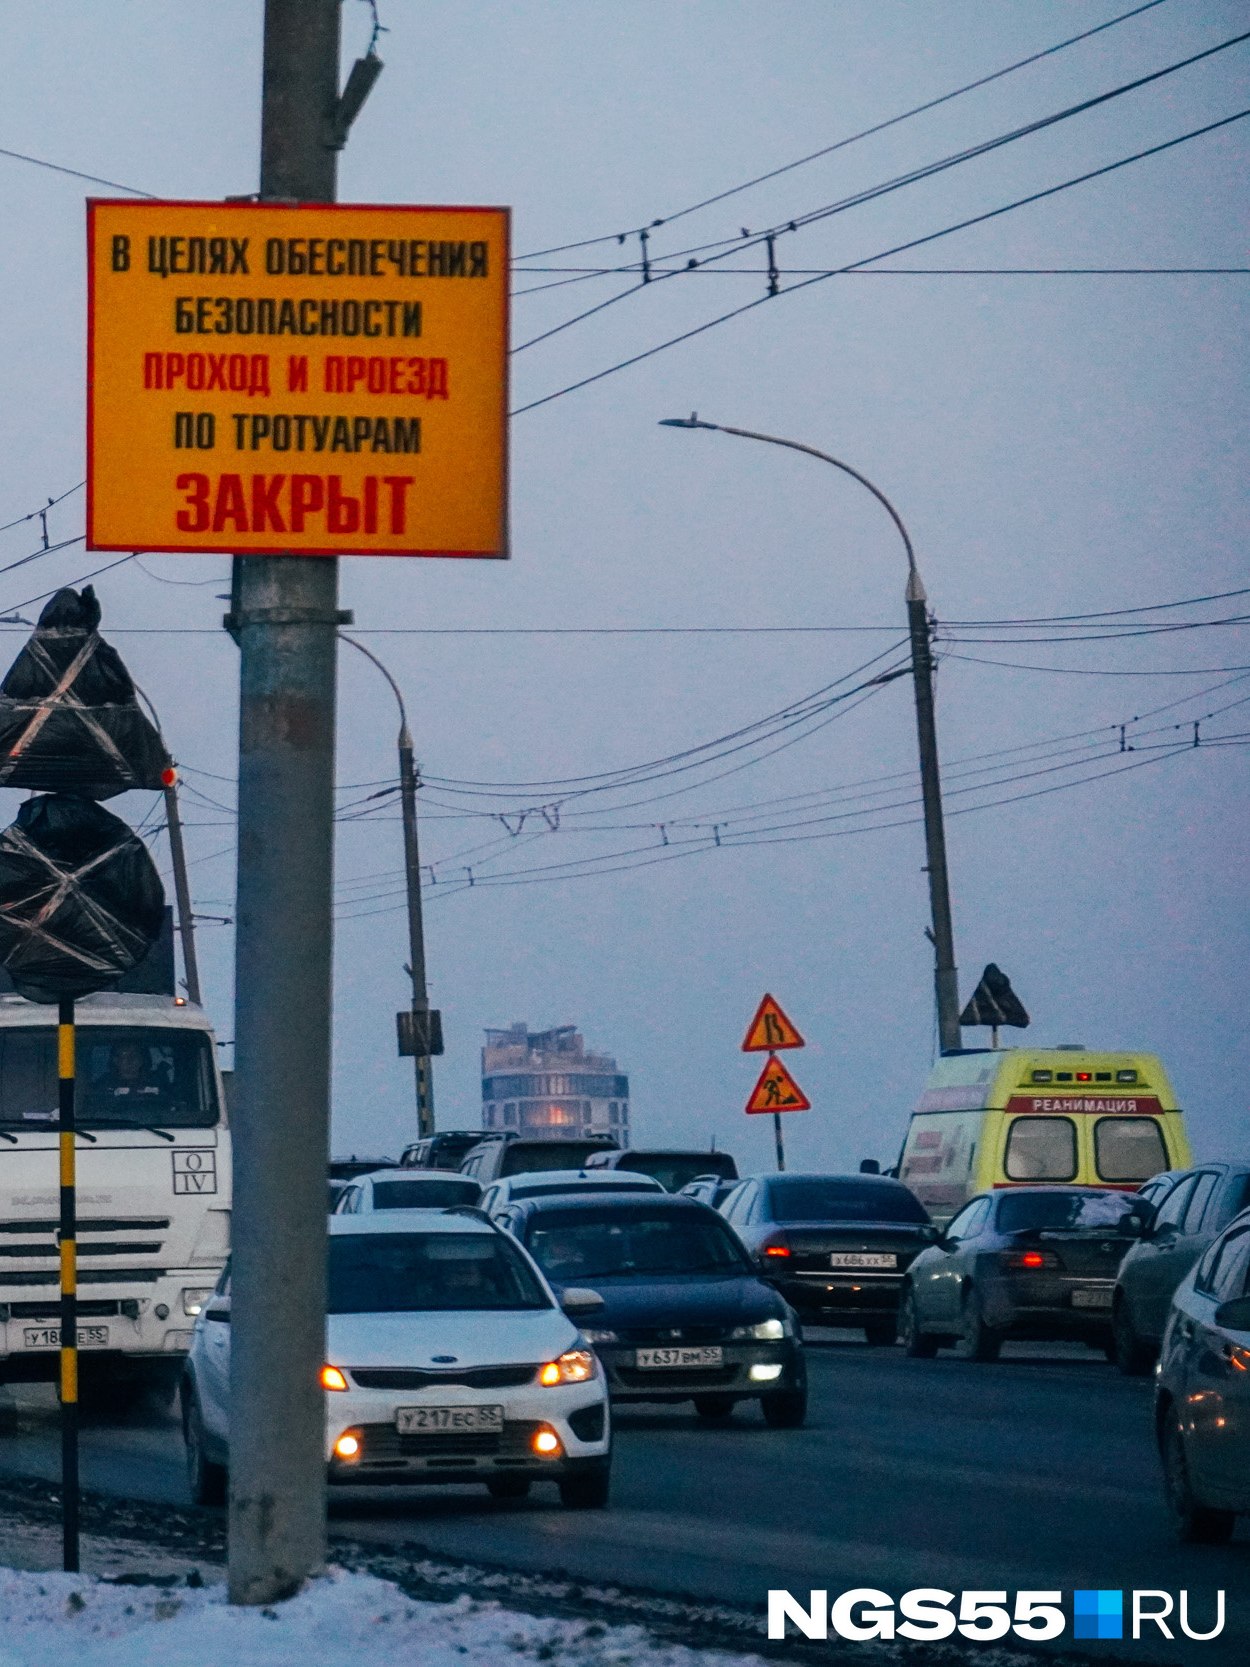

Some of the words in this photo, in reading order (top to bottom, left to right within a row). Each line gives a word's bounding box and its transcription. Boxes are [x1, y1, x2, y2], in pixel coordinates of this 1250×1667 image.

[112, 236, 130, 272] В
[148, 236, 249, 278] ЦЕЛЯХ
[265, 237, 488, 278] ОБЕСПЕЧЕНИЯ
[175, 297, 422, 338] БЕЗОПАСНОСТИ
[143, 352, 270, 396] ПРОХОД
[288, 355, 308, 393] И
[324, 356, 449, 400] ПРОЕЗД
[174, 412, 214, 449] ПО
[232, 414, 421, 453] ТРОТУАРАМ
[175, 473, 415, 535] ЗАКРЫТ
[1033, 1099, 1137, 1112] РЕАНИМАЦИЯ
[184, 1175, 206, 1191] IV
[31, 1330, 85, 1344] У18Е
